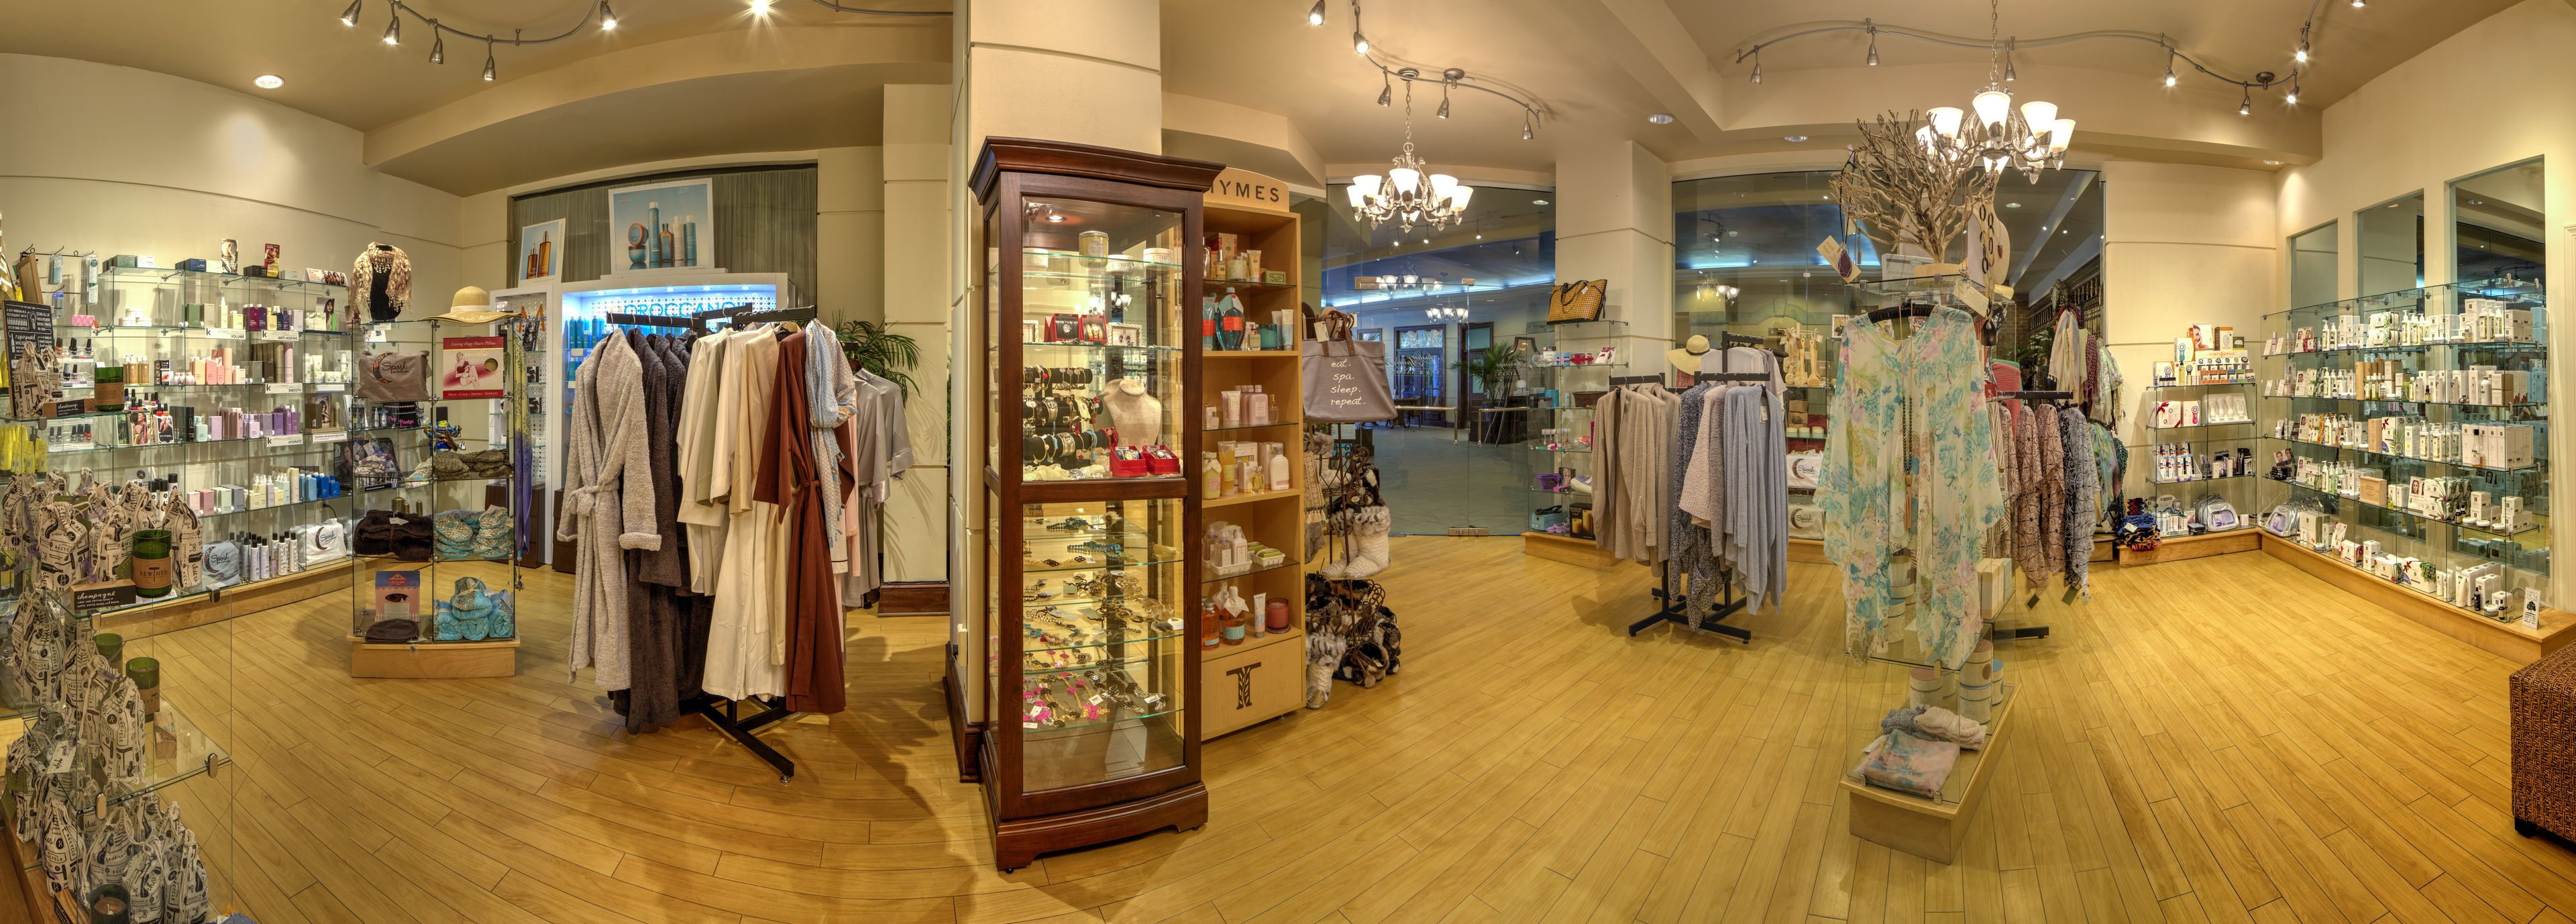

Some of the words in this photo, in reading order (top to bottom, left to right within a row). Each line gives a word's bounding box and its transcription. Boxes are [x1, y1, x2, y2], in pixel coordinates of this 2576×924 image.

[382, 360, 408, 374] Sposh
[1331, 358, 1351, 367] eat.
[1333, 374, 1354, 383] spa.
[1331, 384, 1361, 396] sleep.
[1331, 396, 1366, 408] repeat.
[1798, 465, 1814, 473] Sposh
[211, 553, 229, 564] Sposh
[77, 591, 116, 600] champagne
[66, 834, 76, 857] RECYCLE
